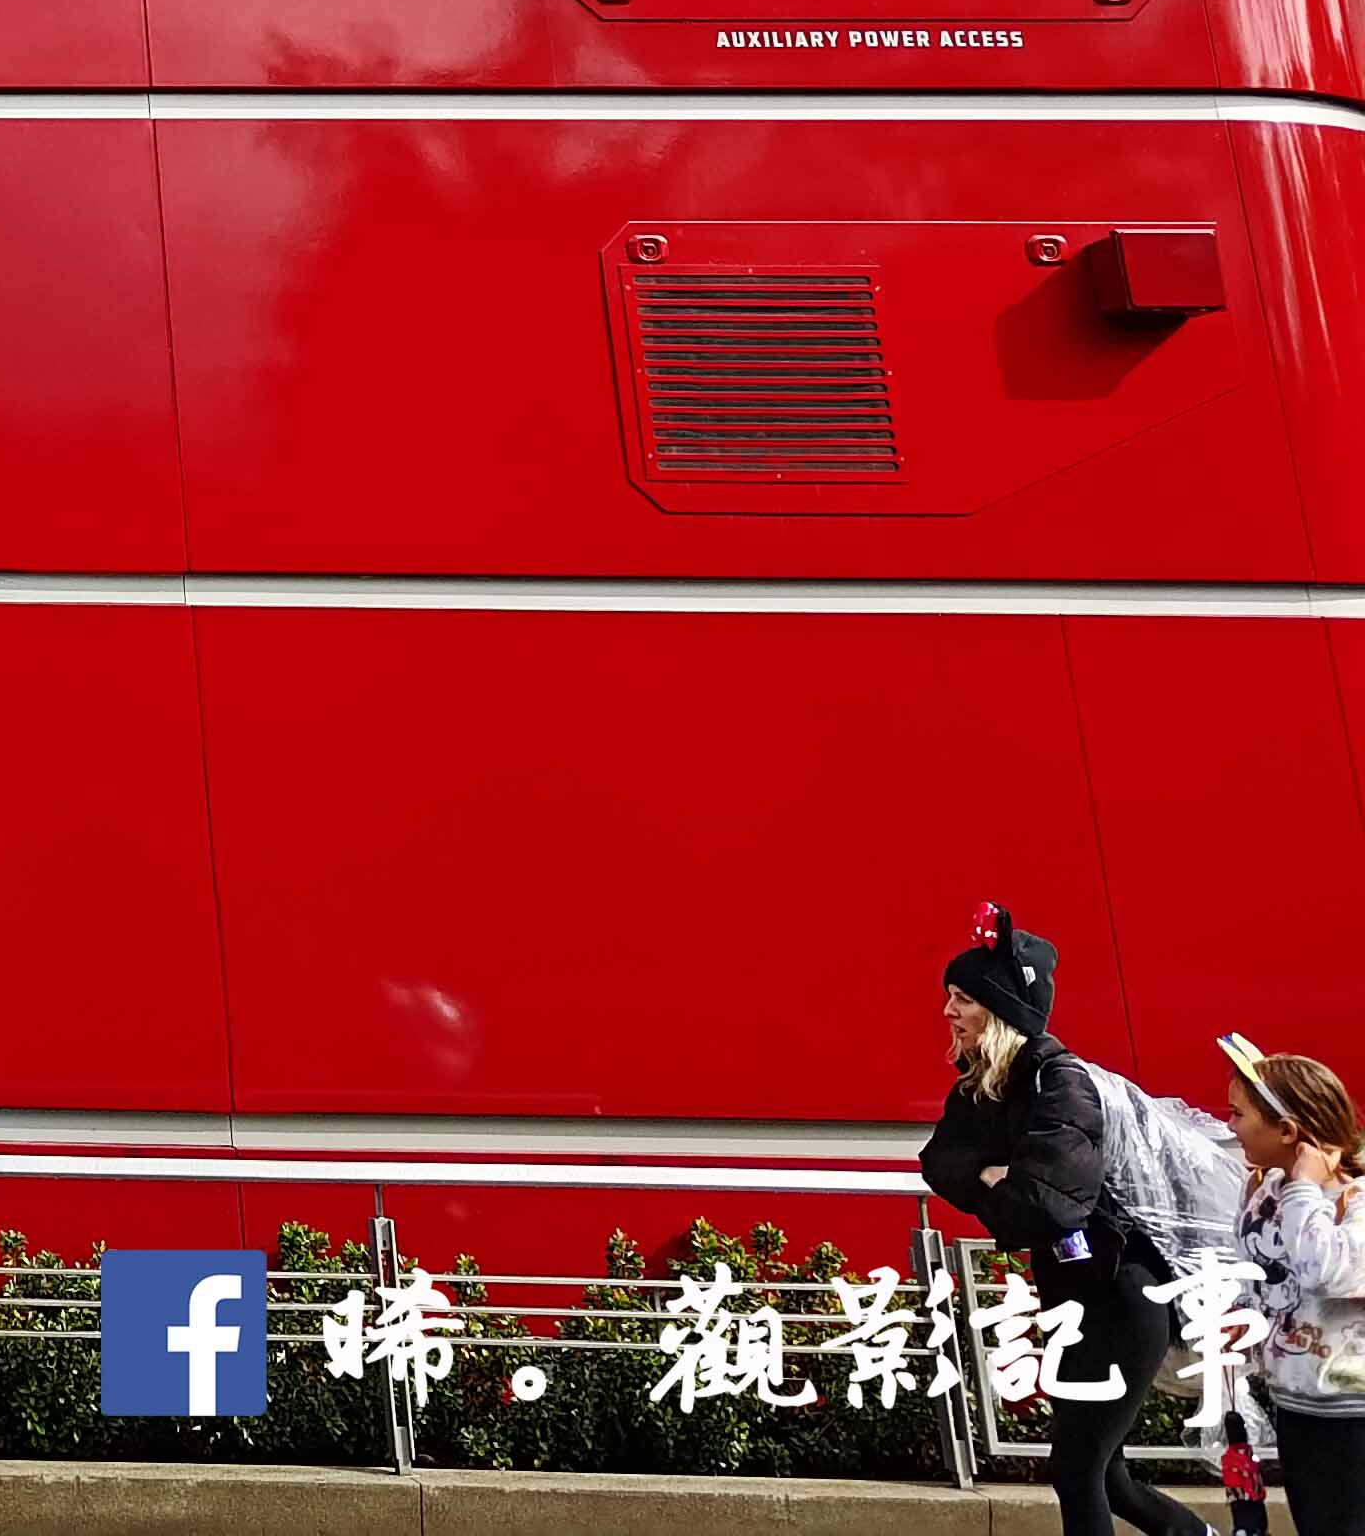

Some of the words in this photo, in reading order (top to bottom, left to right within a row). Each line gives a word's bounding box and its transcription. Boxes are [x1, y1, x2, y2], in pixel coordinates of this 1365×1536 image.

[716, 30, 839, 48] AUXILIARY
[848, 30, 931, 48] POWER
[939, 30, 1024, 48] ACCESS
